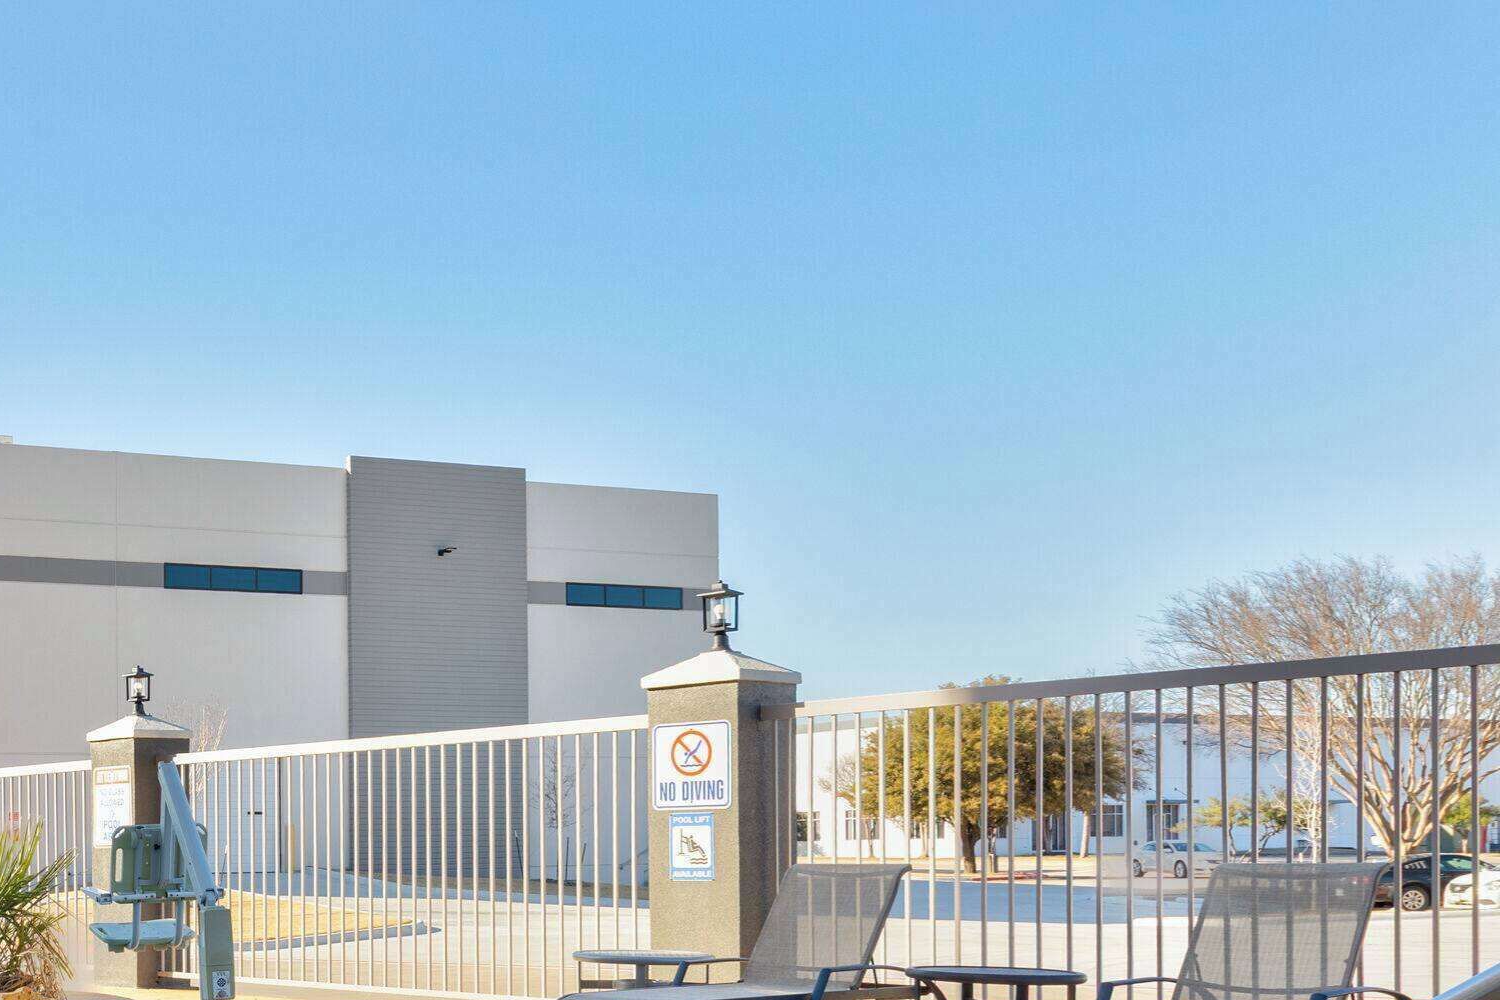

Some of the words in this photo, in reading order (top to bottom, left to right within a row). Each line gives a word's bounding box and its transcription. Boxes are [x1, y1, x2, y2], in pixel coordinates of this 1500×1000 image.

[659, 782, 676, 801] NO
[682, 780, 724, 801] DIVING
[672, 816, 693, 824] POOL
[695, 815, 711, 823] LIFT
[672, 870, 712, 878] AVAILABLE
